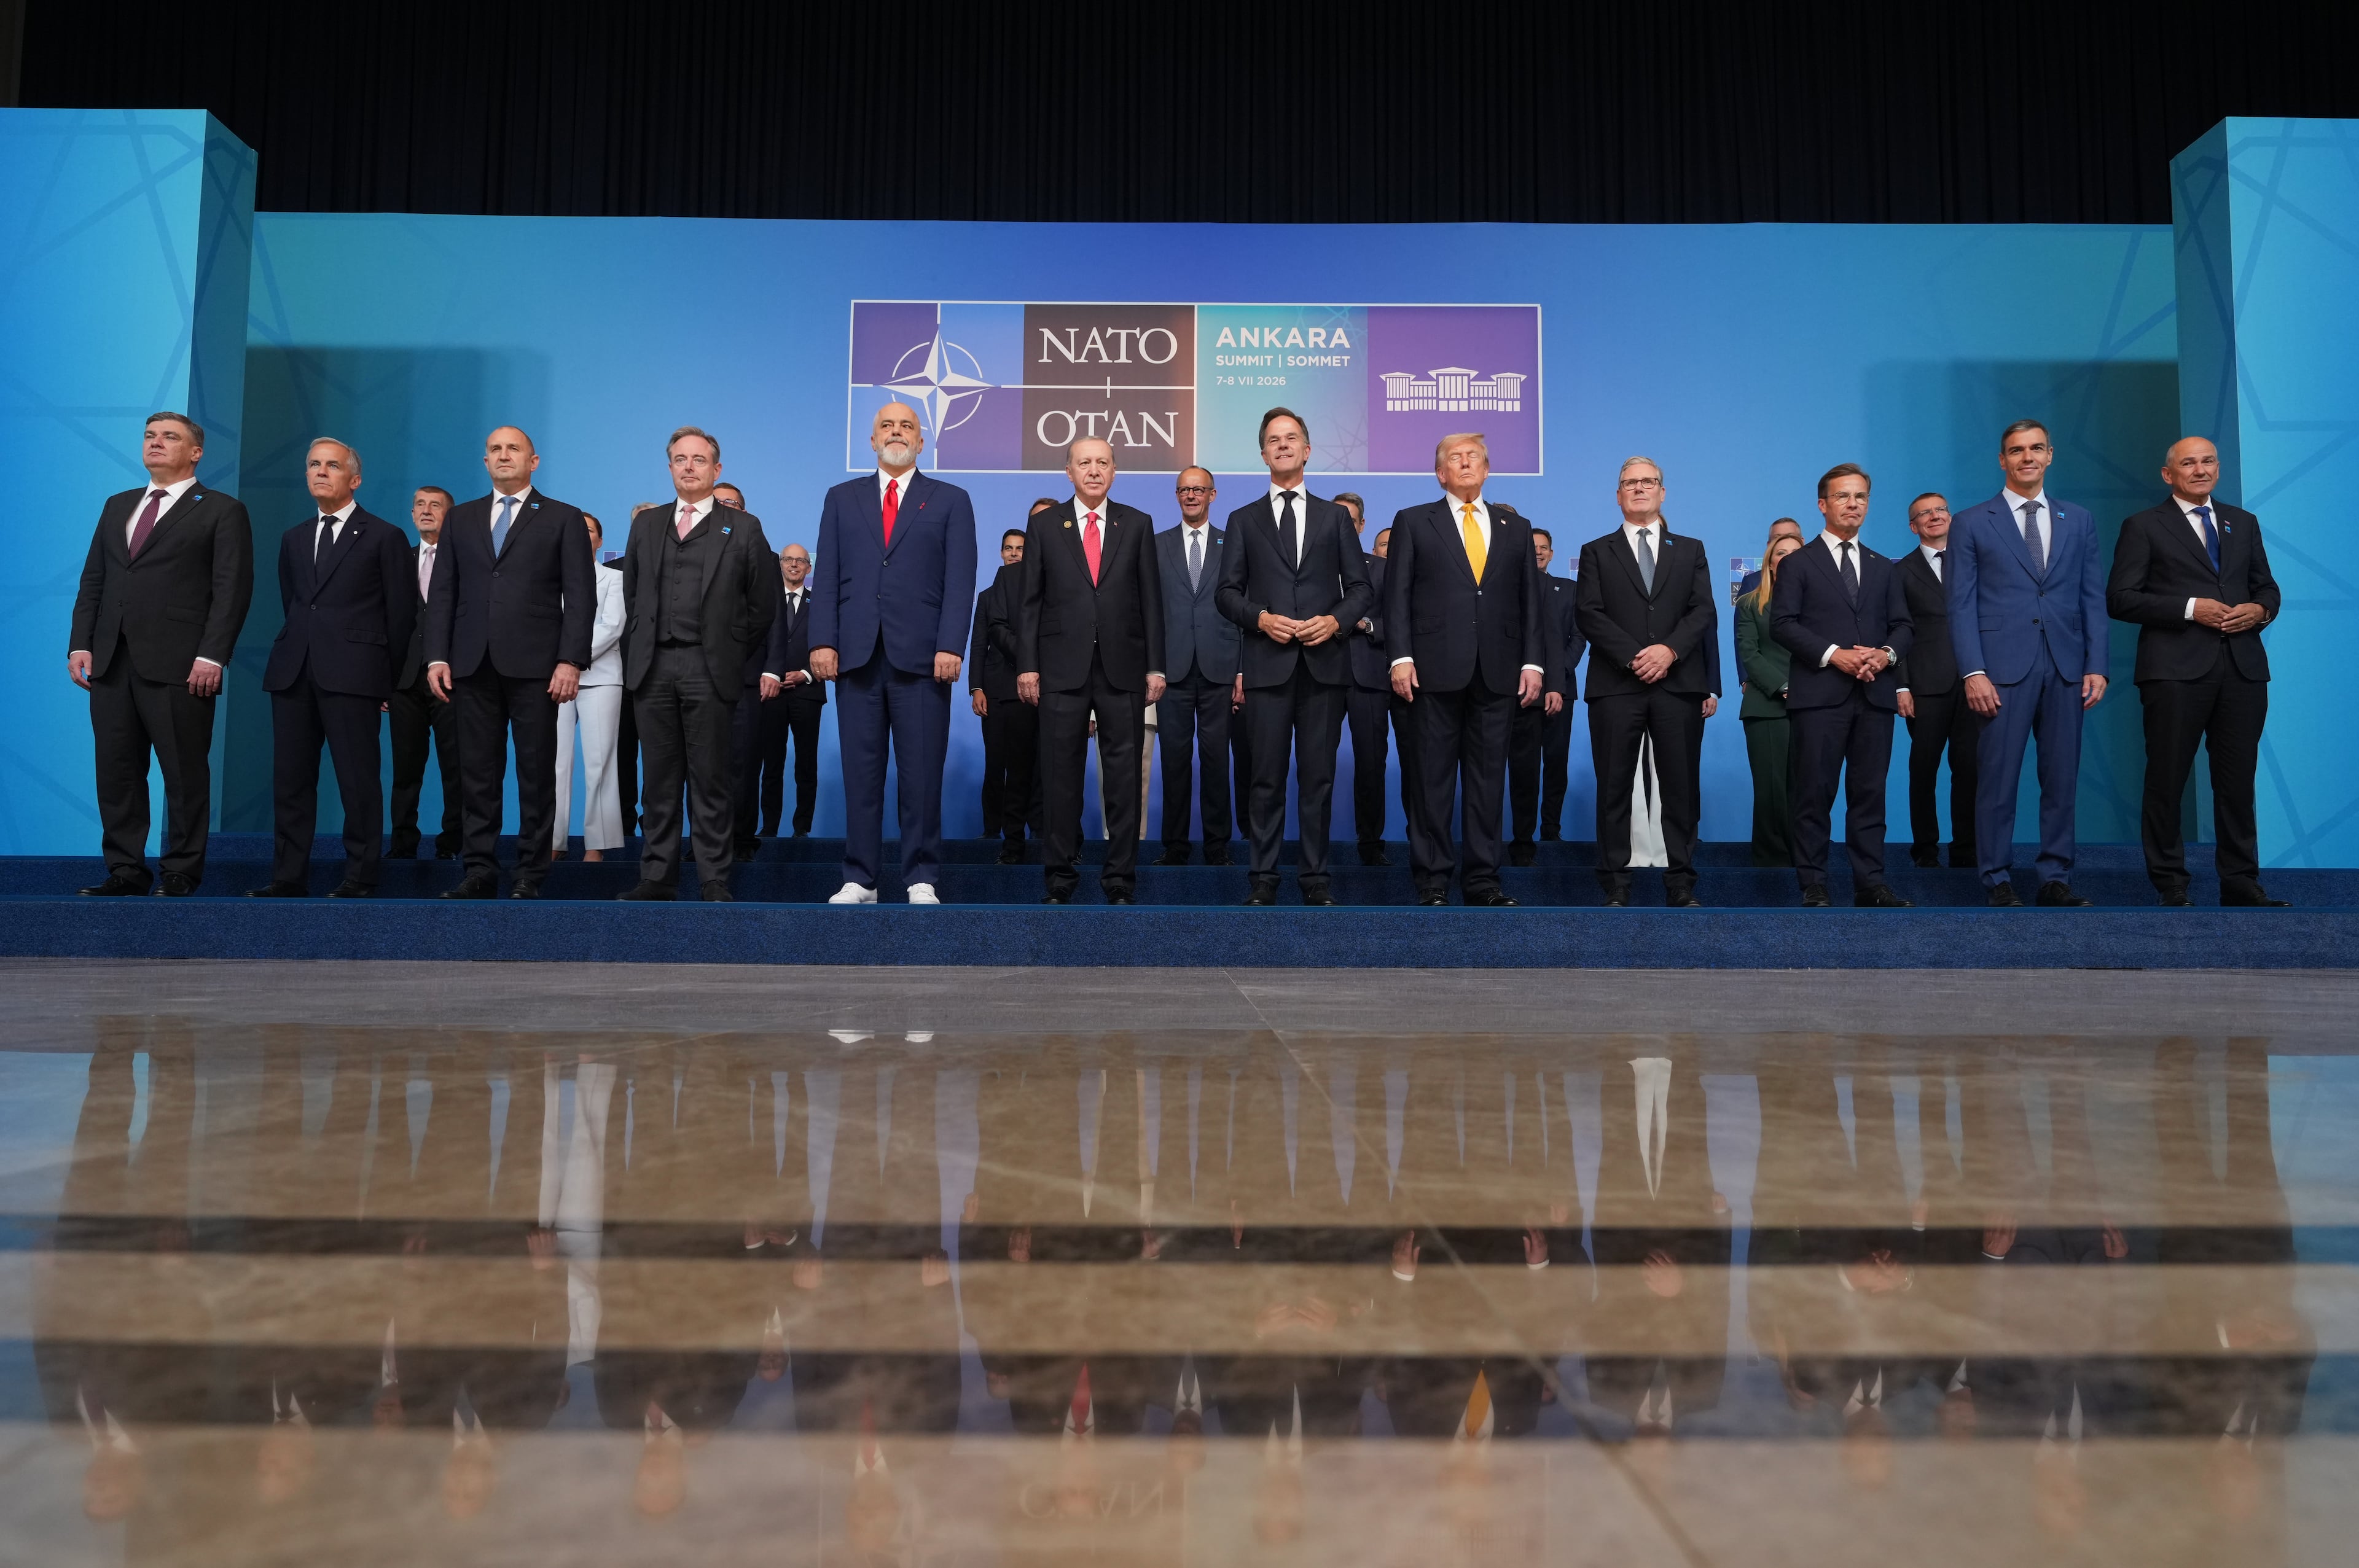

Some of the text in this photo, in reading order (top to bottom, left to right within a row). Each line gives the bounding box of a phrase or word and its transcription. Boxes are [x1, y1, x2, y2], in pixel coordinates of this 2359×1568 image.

[1038, 327, 1178, 364] NATO
[1216, 327, 1350, 348] ANKARA
[1216, 355, 1273, 366] SUMMIT
[1287, 356, 1351, 367] SOMMET
[1216, 376, 1286, 386] 7-8 VII 2026
[1037, 410, 1179, 448] OTAN
